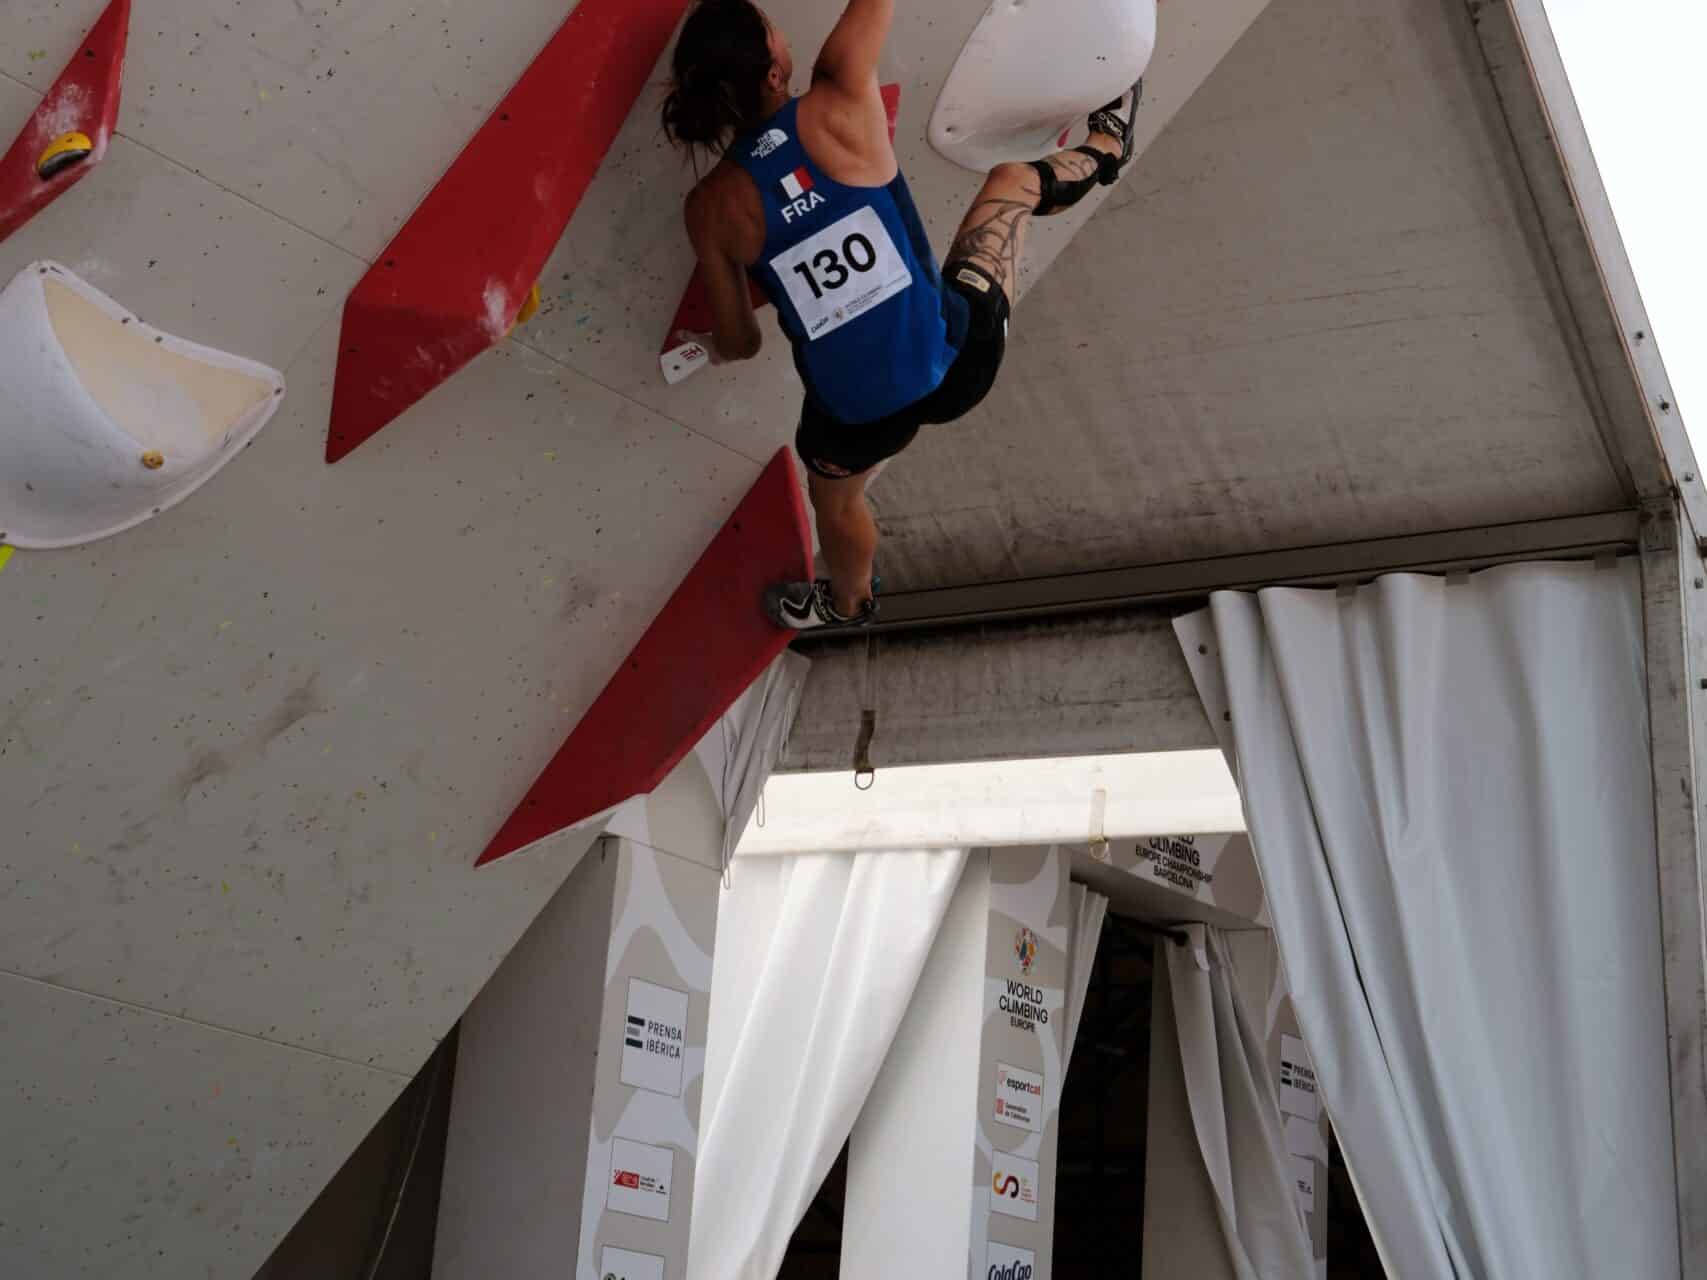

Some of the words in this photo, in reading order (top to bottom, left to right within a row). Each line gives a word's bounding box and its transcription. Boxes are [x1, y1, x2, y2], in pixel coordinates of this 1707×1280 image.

[780, 191, 827, 224] FRA
[793, 232, 877, 300] 130
[1006, 978, 1043, 1005] WORLD
[999, 995, 1048, 1024] CLIMBING
[647, 1019, 683, 1042] PRENSA
[1010, 1016, 1036, 1033] EUROPE
[645, 1038, 681, 1059] IBÉRICA
[1006, 1077, 1041, 1096] esportcat
